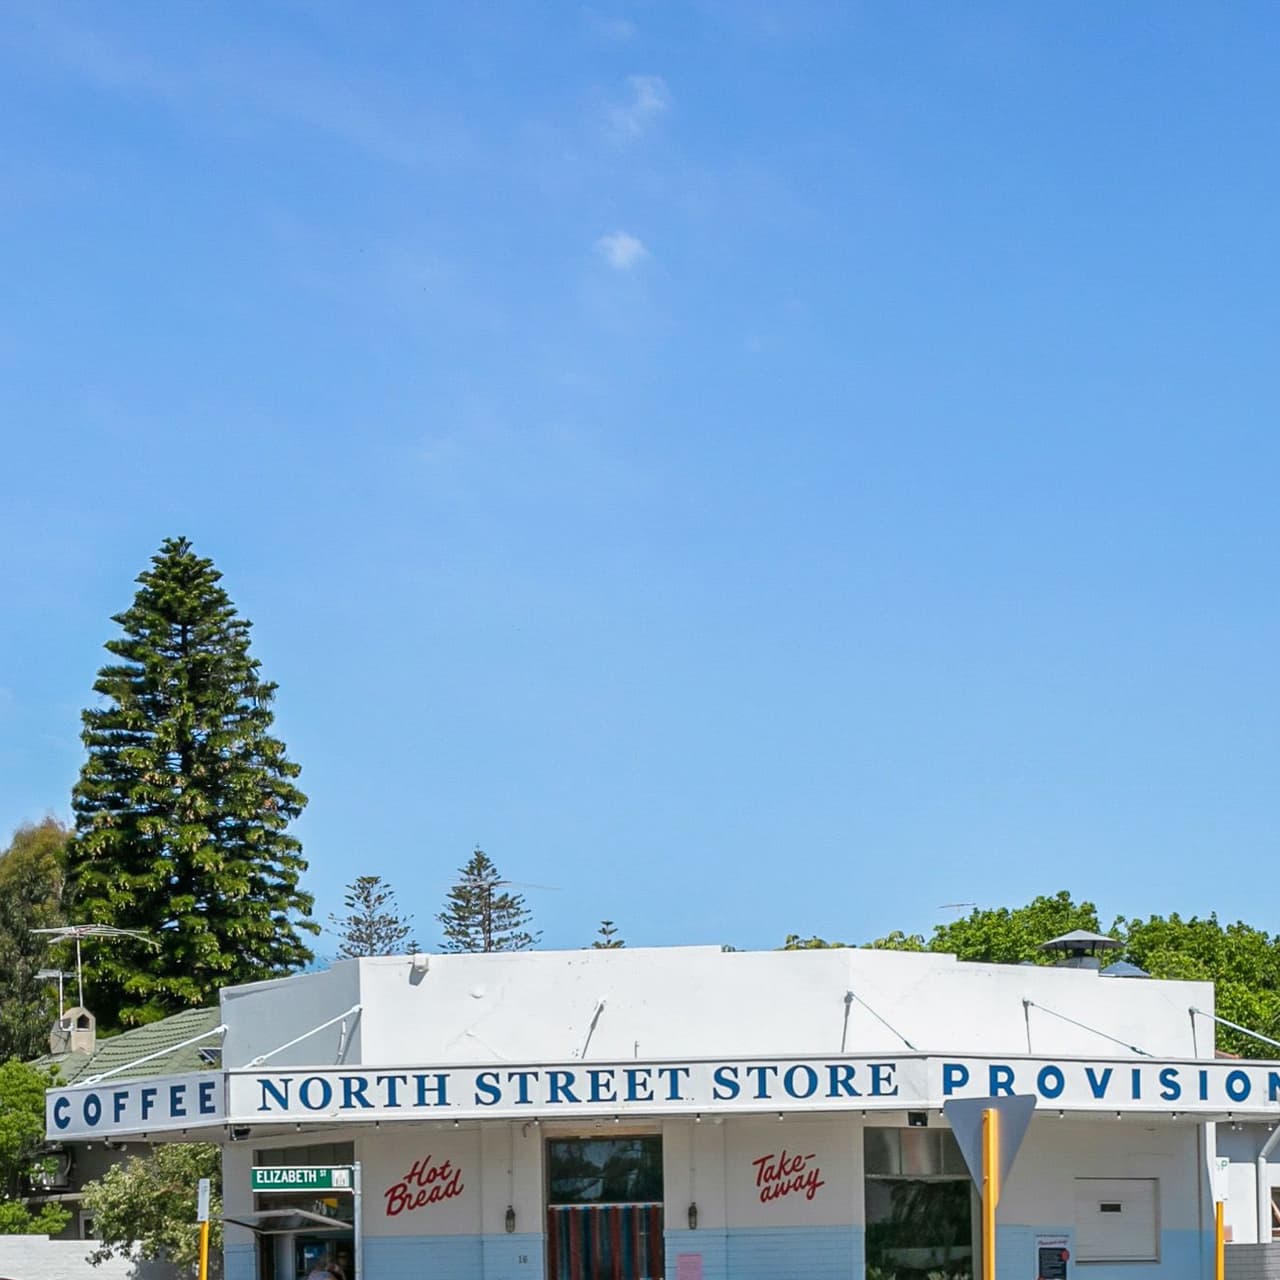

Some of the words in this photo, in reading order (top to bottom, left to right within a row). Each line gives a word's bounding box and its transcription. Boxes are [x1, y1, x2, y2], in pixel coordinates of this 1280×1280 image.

[53, 1082, 216, 1130] COFFEE
[257, 1073, 451, 1112] NORTH
[474, 1067, 690, 1106] STREET
[713, 1063, 899, 1099] STORE
[256, 1169, 317, 1183] ELIZABETH
[403, 1155, 453, 1187] Hot
[752, 1150, 816, 1187] Take-
[760, 1168, 825, 1203] away
[384, 1169, 465, 1216] Bread
